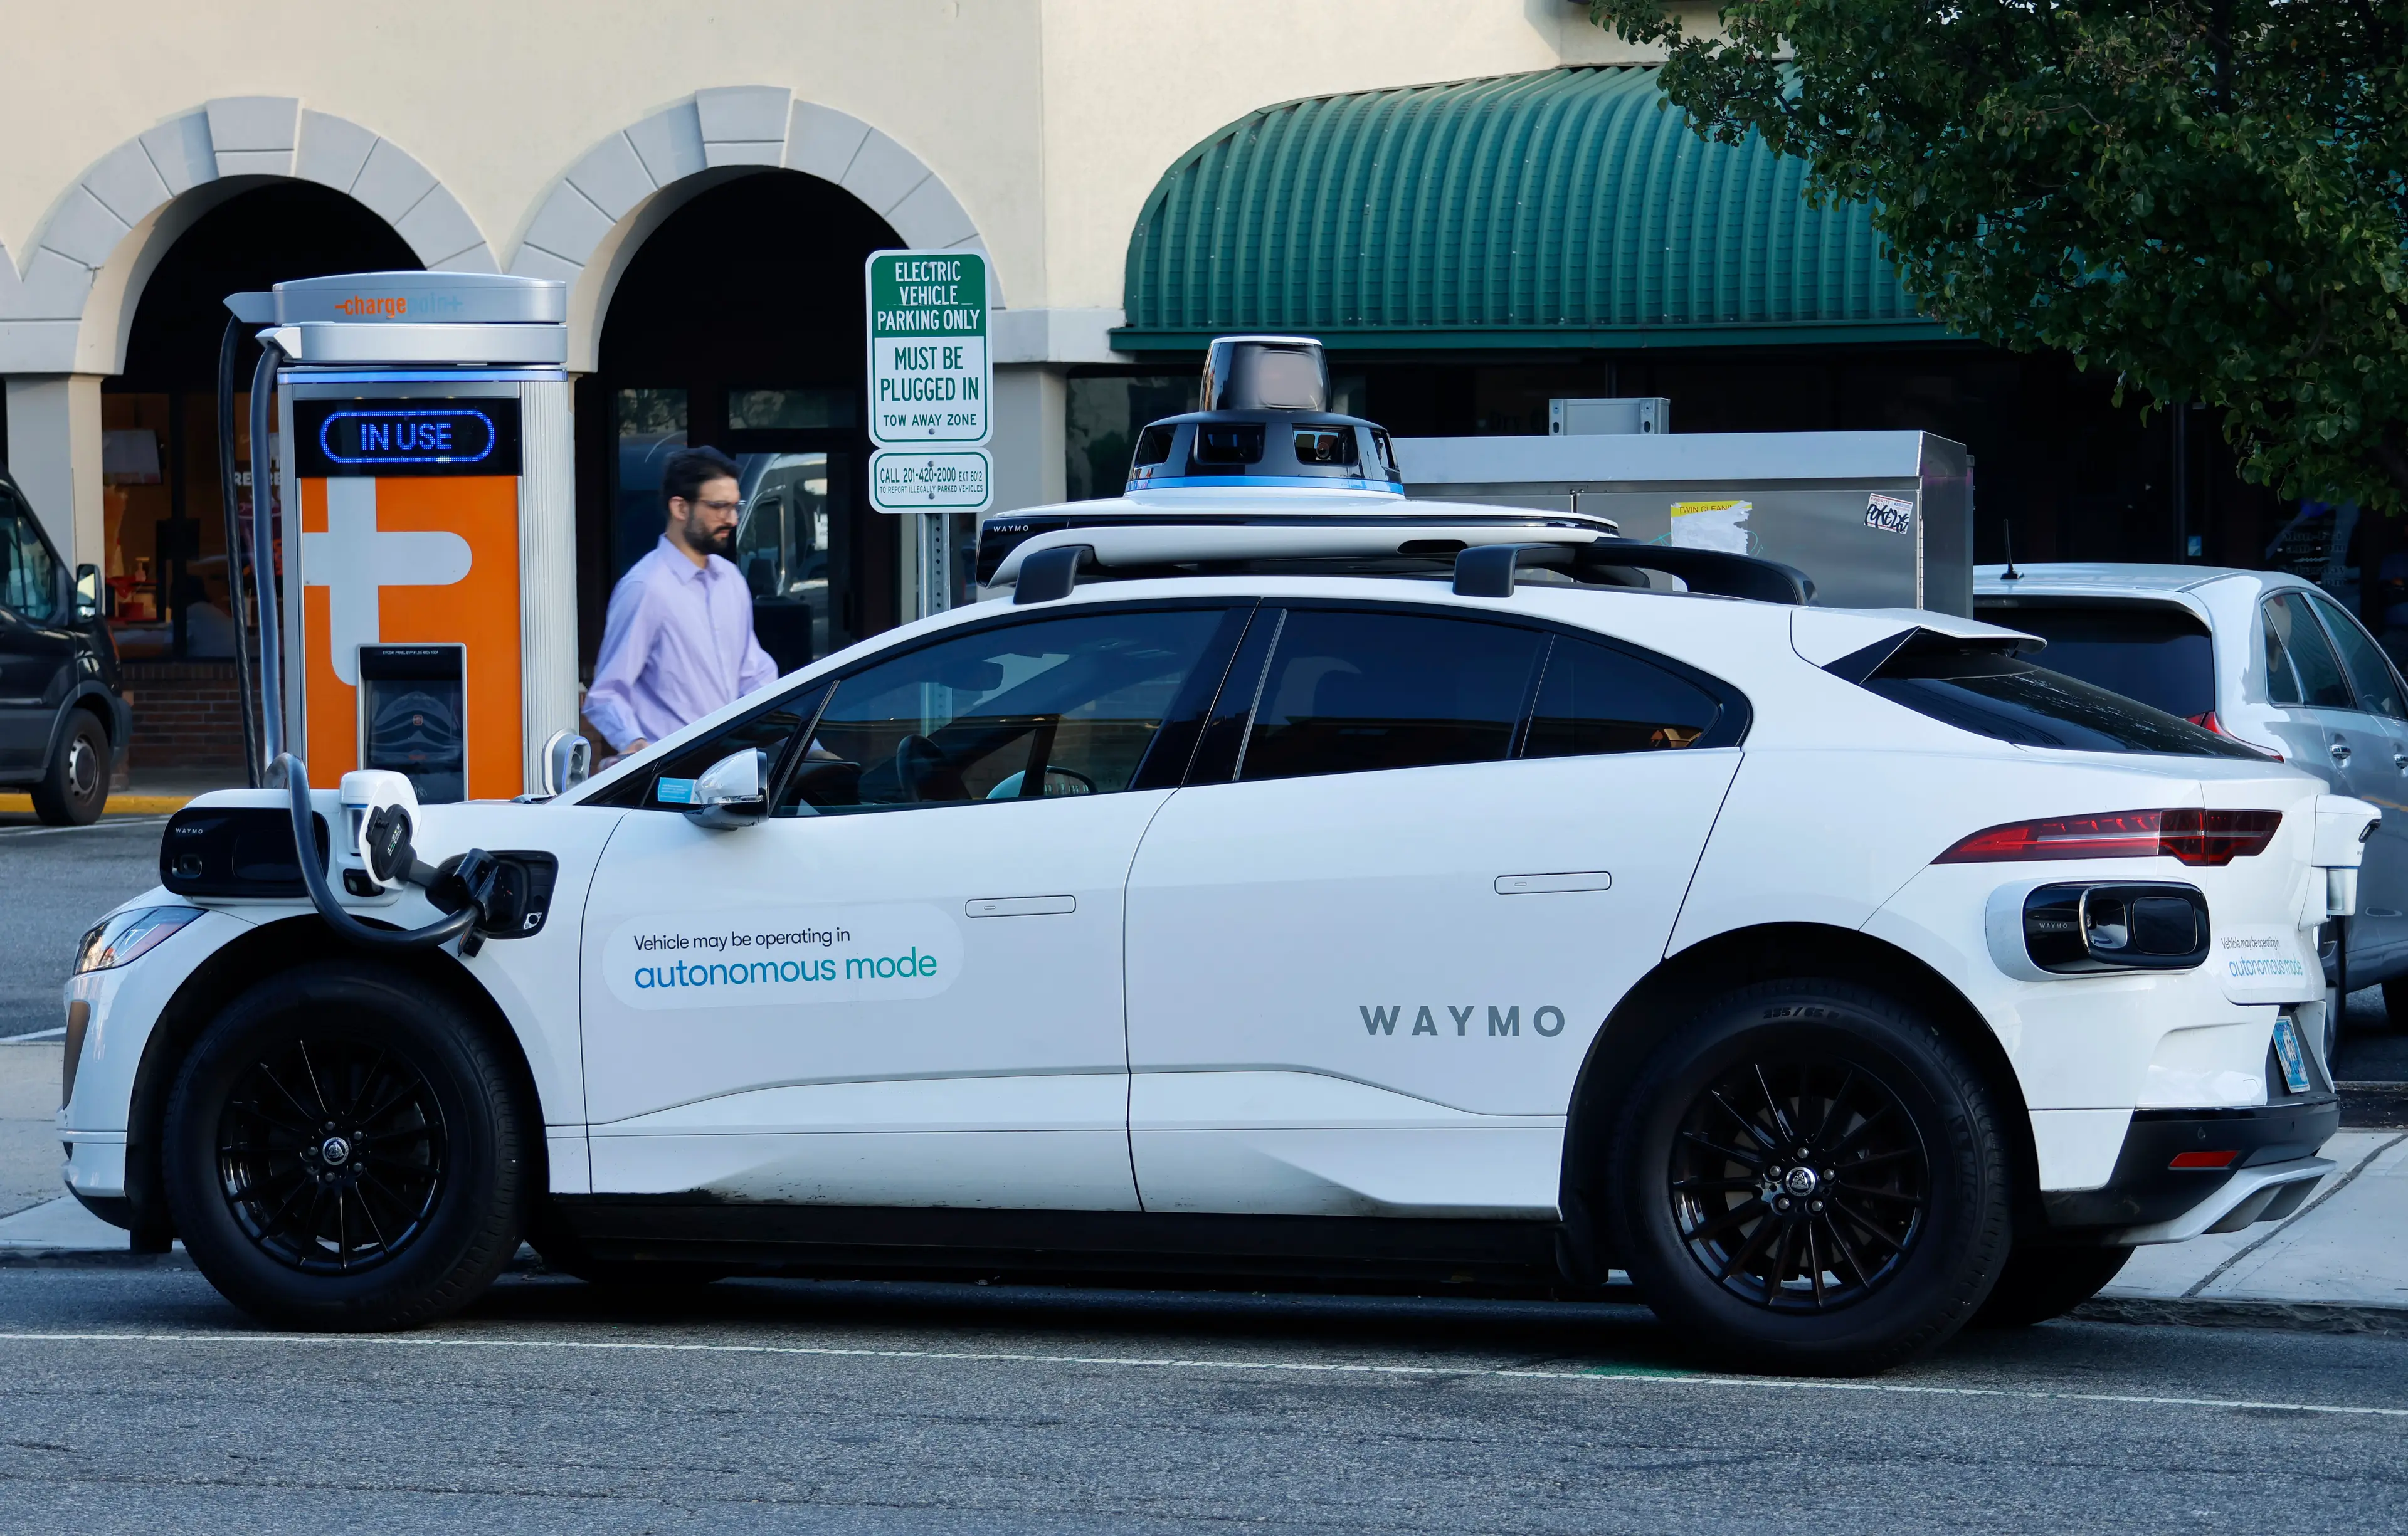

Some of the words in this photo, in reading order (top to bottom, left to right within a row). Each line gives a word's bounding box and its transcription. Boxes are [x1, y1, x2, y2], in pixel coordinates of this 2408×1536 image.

[895, 261, 961, 282] ELECTRIC
[899, 285, 958, 306] VEHICLE
[877, 310, 939, 331] PARKING
[943, 309, 980, 330] ONLY
[895, 347, 937, 371] MUST
[943, 346, 963, 370] BE
[881, 377, 956, 401] PLUGGED
[963, 377, 978, 401] IN
[884, 414, 907, 426] TOW
[912, 414, 942, 426] AWAY
[947, 414, 977, 426] ZONE
[361, 423, 389, 450] IN
[396, 423, 452, 450] USE
[880, 468, 900, 483] CALL
[903, 466, 956, 483] 201-420-2000
[959, 471, 969, 482] EXT
[970, 471, 983, 481] 8012
[937, 485, 958, 493] PARKED
[1679, 505, 1699, 513] TWIN
[634, 934, 689, 952] Vehicle
[693, 935, 728, 952] may
[731, 930, 752, 948] be
[755, 928, 833, 949] operating
[837, 926, 850, 944] in
[2221, 936, 2241, 949] Vehicle
[2240, 940, 2252, 951] may
[2251, 936, 2258, 947] be
[2258, 936, 2278, 951] operating
[634, 954, 837, 989] autonomous
[845, 946, 937, 979] mode
[2229, 956, 2285, 977] autonomous
[2283, 953, 2303, 976] mode
[1358, 1004, 1566, 1038] WAYMO
